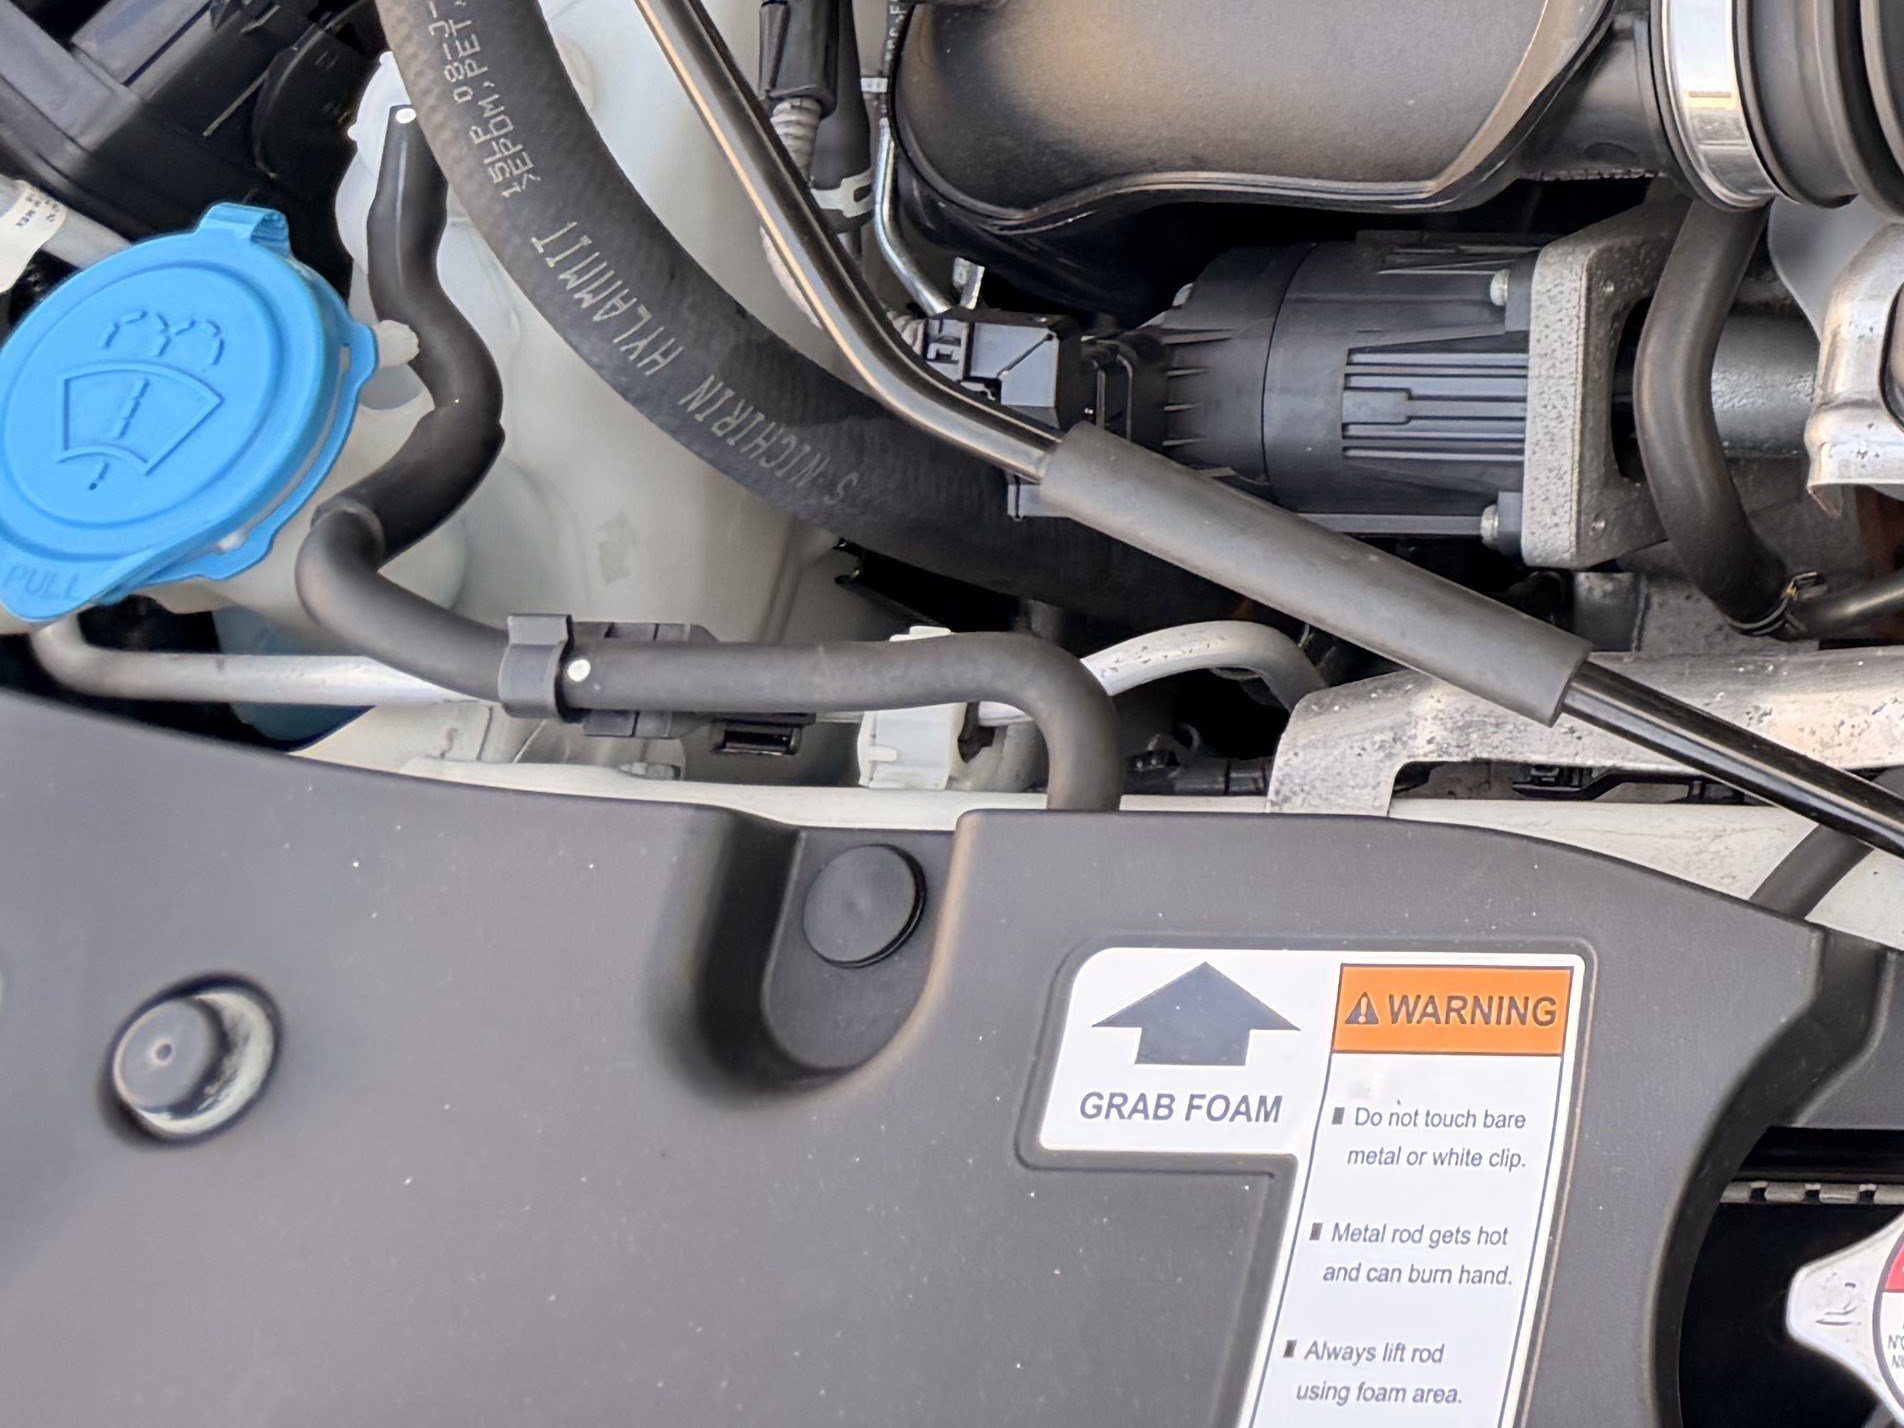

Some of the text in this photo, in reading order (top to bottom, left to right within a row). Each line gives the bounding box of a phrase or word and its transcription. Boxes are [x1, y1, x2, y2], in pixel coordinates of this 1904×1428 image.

[4, 561, 83, 601] PULL
[1389, 994, 1558, 1027] WARNING
[1078, 1092, 1283, 1123] GRAB FOAM
[1354, 1107, 1526, 1131] Do not touch bare
[1347, 1146, 1527, 1173] metal or white clip.
[1331, 1223, 1509, 1250] Metal rod gets hot
[1322, 1262, 1513, 1286] and can burn hand.
[1303, 1341, 1445, 1364] Always lift rod
[1296, 1381, 1464, 1406] using foam area.
